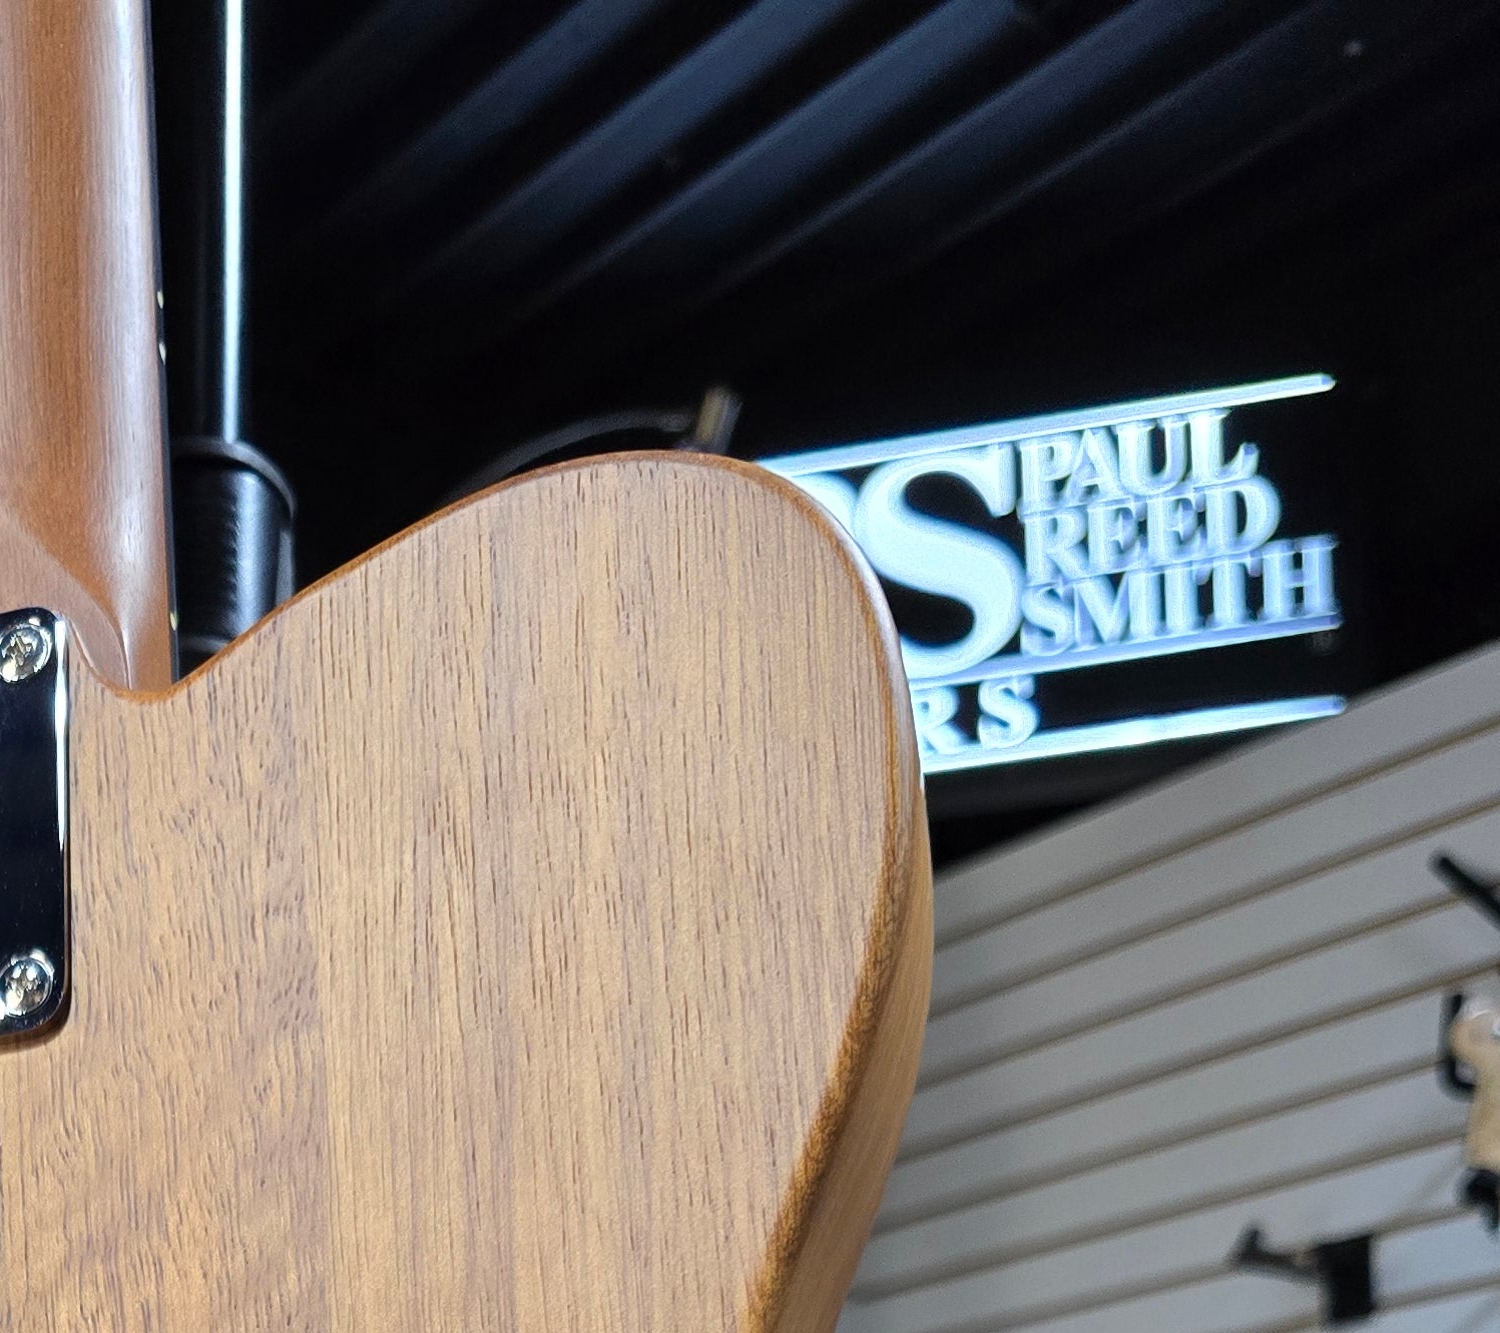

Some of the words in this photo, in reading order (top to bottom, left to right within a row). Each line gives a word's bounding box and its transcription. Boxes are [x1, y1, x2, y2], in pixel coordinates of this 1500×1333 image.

[1018, 409, 1260, 514] PAUL
[1022, 474, 1282, 586] REED
[1019, 535, 1341, 657] SMITH
